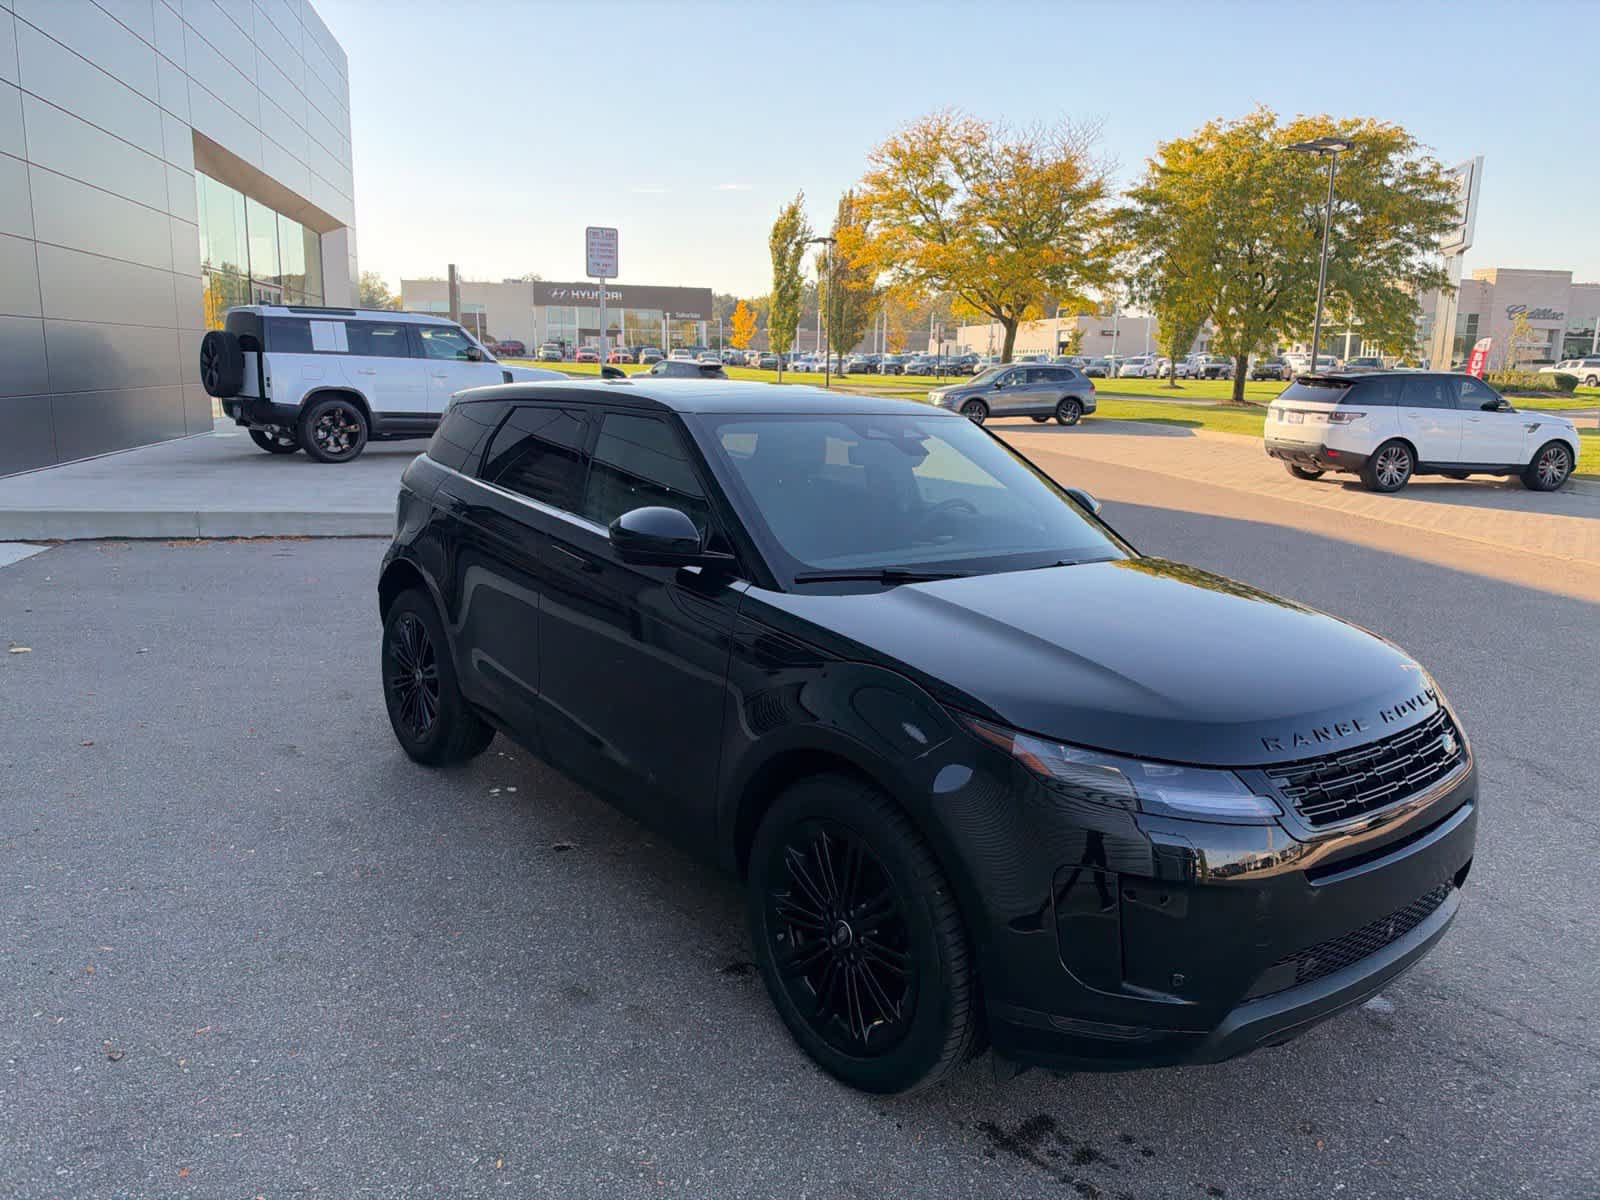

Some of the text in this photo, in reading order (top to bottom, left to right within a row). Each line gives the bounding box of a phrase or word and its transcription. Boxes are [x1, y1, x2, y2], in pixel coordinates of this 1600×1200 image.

[1506, 305, 1564, 320] Cdillac
[1260, 687, 1438, 752] RANGE ROVER
